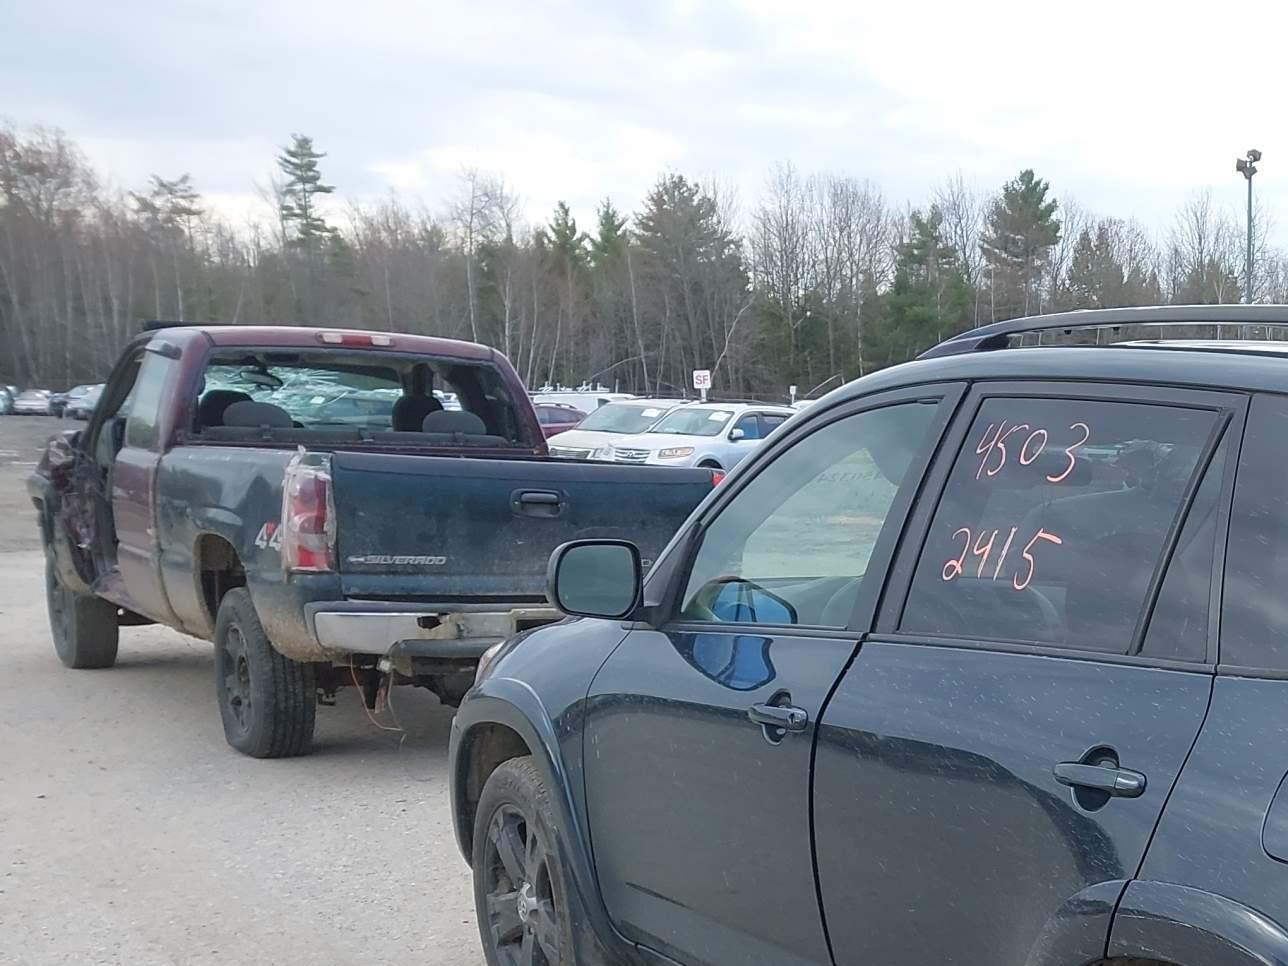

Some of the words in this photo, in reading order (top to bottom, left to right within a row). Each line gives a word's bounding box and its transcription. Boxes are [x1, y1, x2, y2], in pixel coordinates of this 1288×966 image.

[695, 374, 709, 385] SF
[976, 419, 1090, 482] 4503
[365, 555, 447, 566] SILVERADO
[942, 526, 1063, 590] 2415
